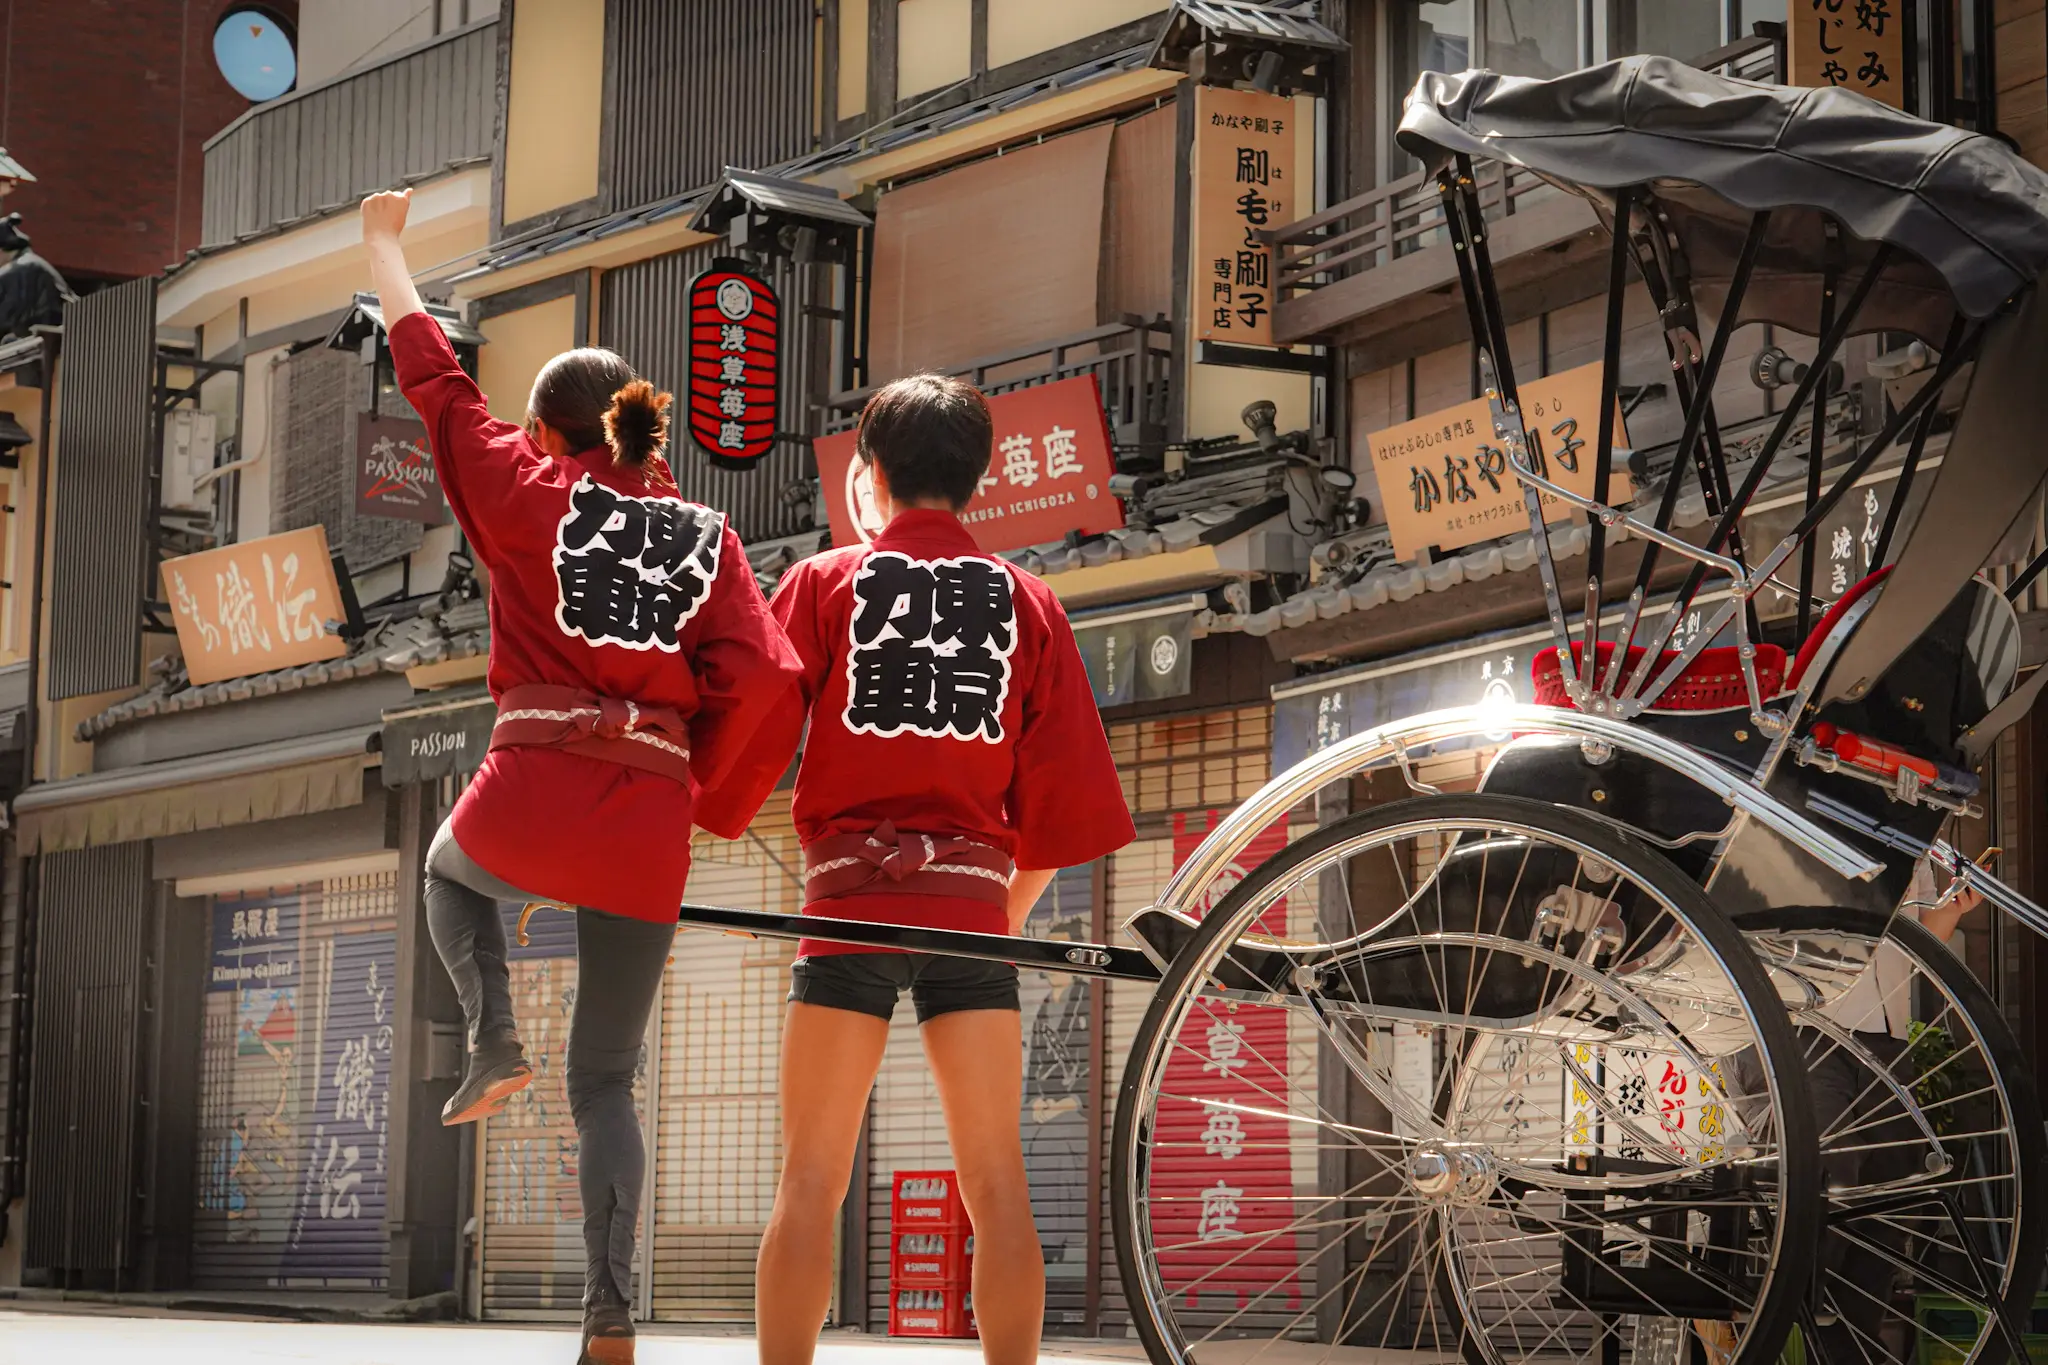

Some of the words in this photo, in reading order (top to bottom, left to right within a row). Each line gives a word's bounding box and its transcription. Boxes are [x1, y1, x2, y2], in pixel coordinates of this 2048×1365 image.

[1211, 112, 1285, 135] かなや刷子
[1236, 147, 1269, 328] 刷毛と刷子
[1213, 258, 1232, 329] 専門店
[718, 323, 747, 450] 浅草苺座
[364, 459, 435, 484] PASSION
[976, 425, 1084, 497] 苺座
[1379, 418, 1475, 462] はけとぶらしの専門店
[957, 505, 1005, 525] AKUSA
[1009, 491, 1076, 516] ICHIGOZA
[1830, 526, 1853, 594] 焼き
[846, 553, 938, 735] 力車
[930, 558, 1016, 742] 東京
[1481, 655, 1515, 680] 東京
[410, 731, 466, 757] PASSION
[212, 965, 252, 982] Kimono
[254, 960, 294, 979] Gallery
[1197, 998, 1249, 1243] 草苺座
